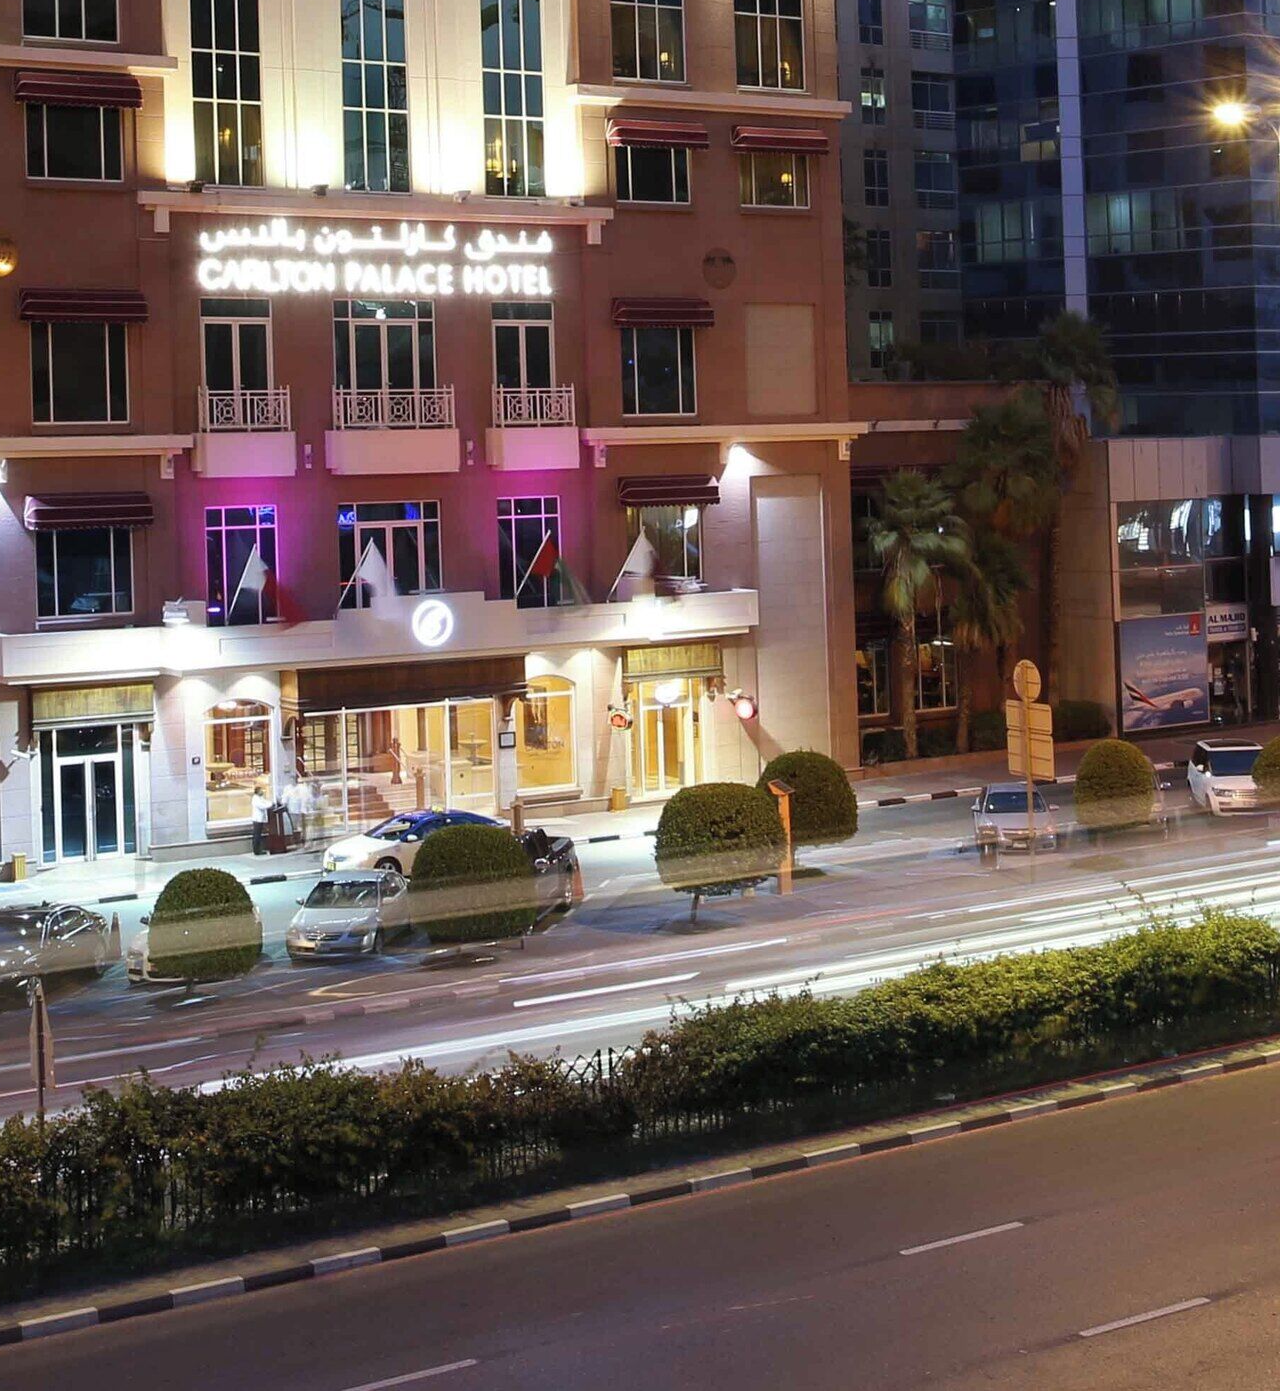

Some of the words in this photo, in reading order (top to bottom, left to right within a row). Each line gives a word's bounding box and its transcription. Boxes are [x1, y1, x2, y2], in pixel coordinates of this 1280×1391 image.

[313, 222, 456, 256] كارلتون
[464, 229, 554, 260] فندق
[199, 258, 336, 292] CARLTON
[344, 261, 454, 294] PALACE
[463, 264, 553, 295] HOTEL
[1220, 613, 1246, 623] MAJID
